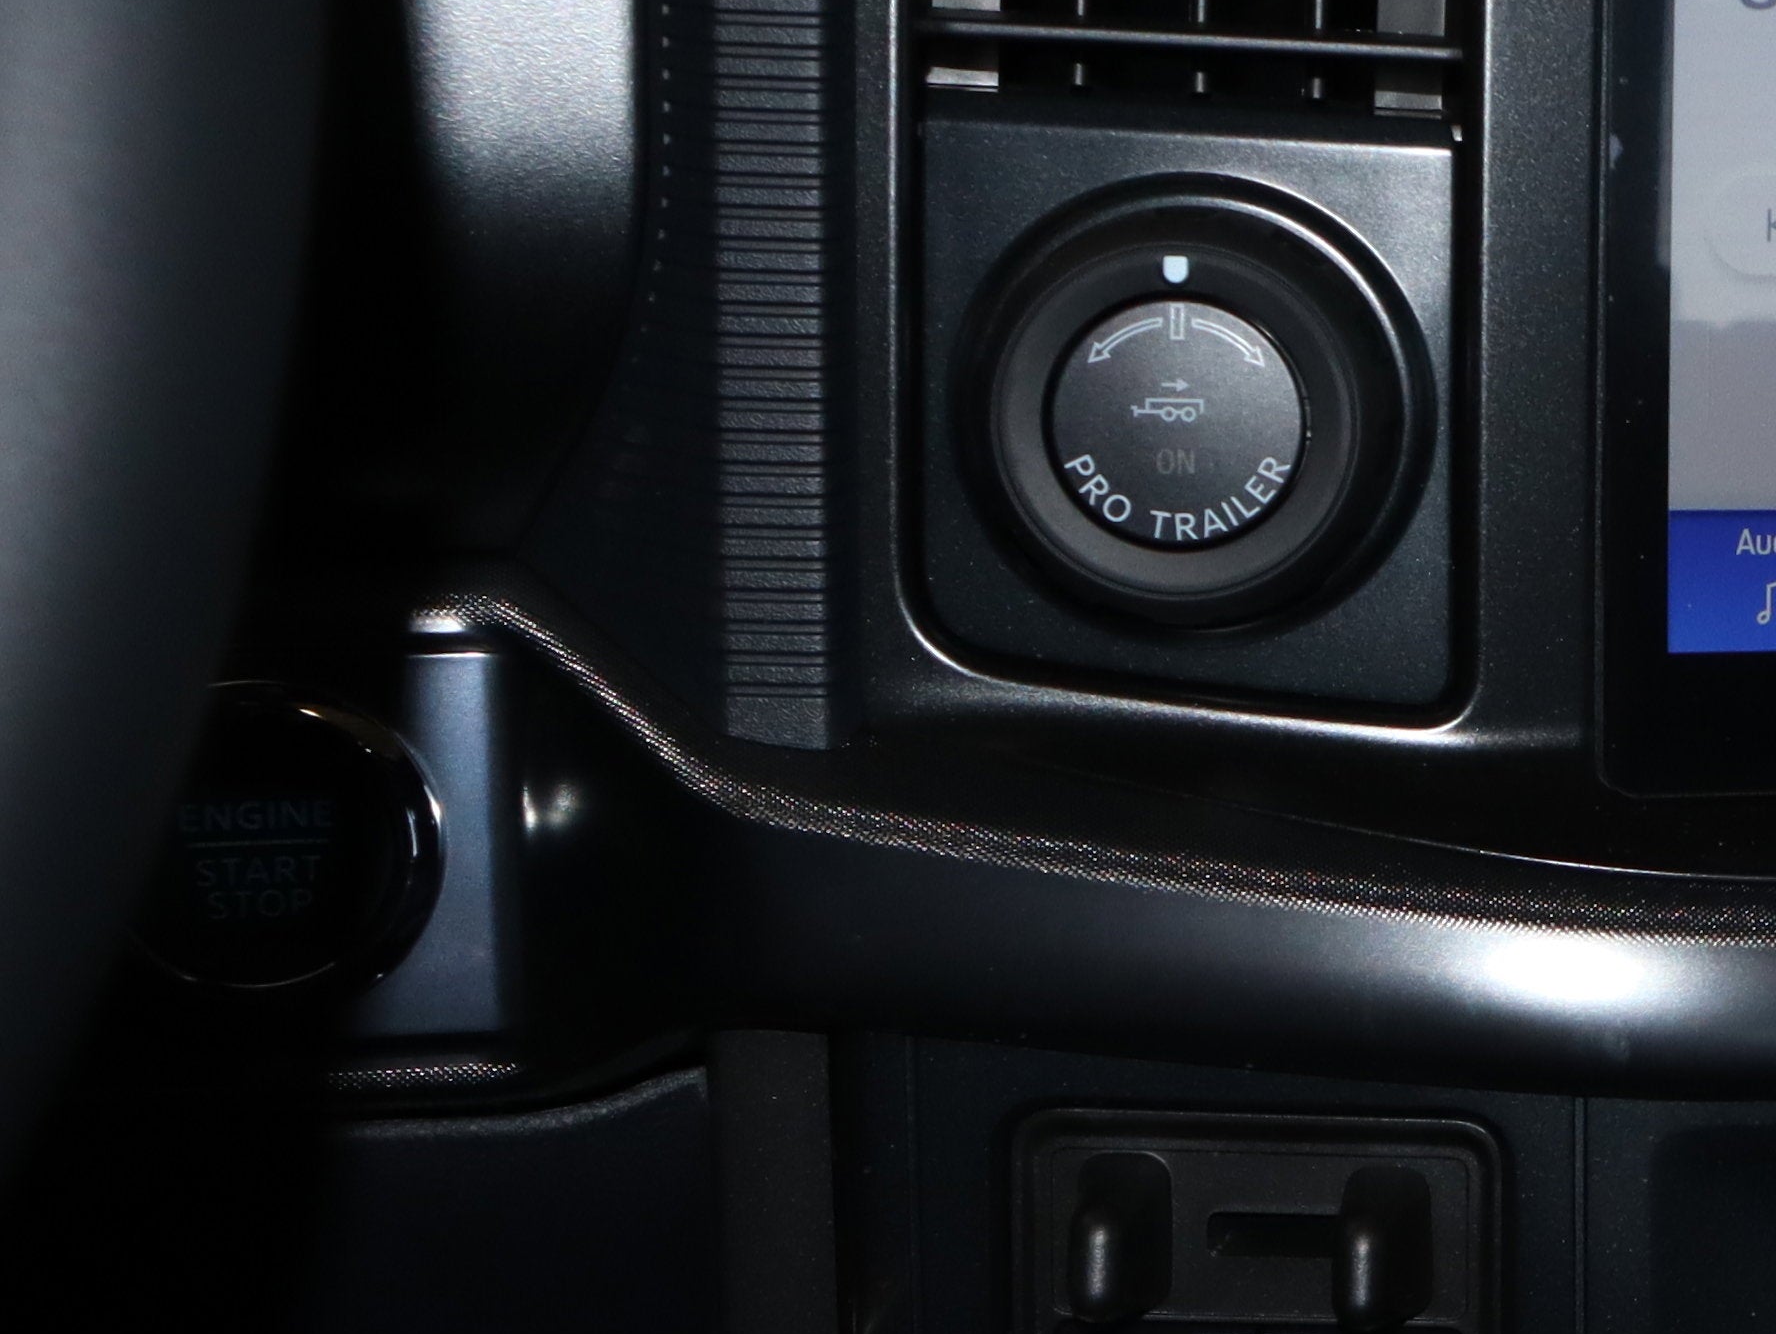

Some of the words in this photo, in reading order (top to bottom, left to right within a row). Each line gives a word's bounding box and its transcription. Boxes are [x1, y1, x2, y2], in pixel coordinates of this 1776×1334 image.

[1156, 448, 1196, 475] ON
[1064, 454, 1132, 523] PRO
[1150, 456, 1291, 542] TRAILER
[180, 799, 334, 832] ENGINE
[195, 854, 322, 887] START
[208, 889, 313, 920] STOP
